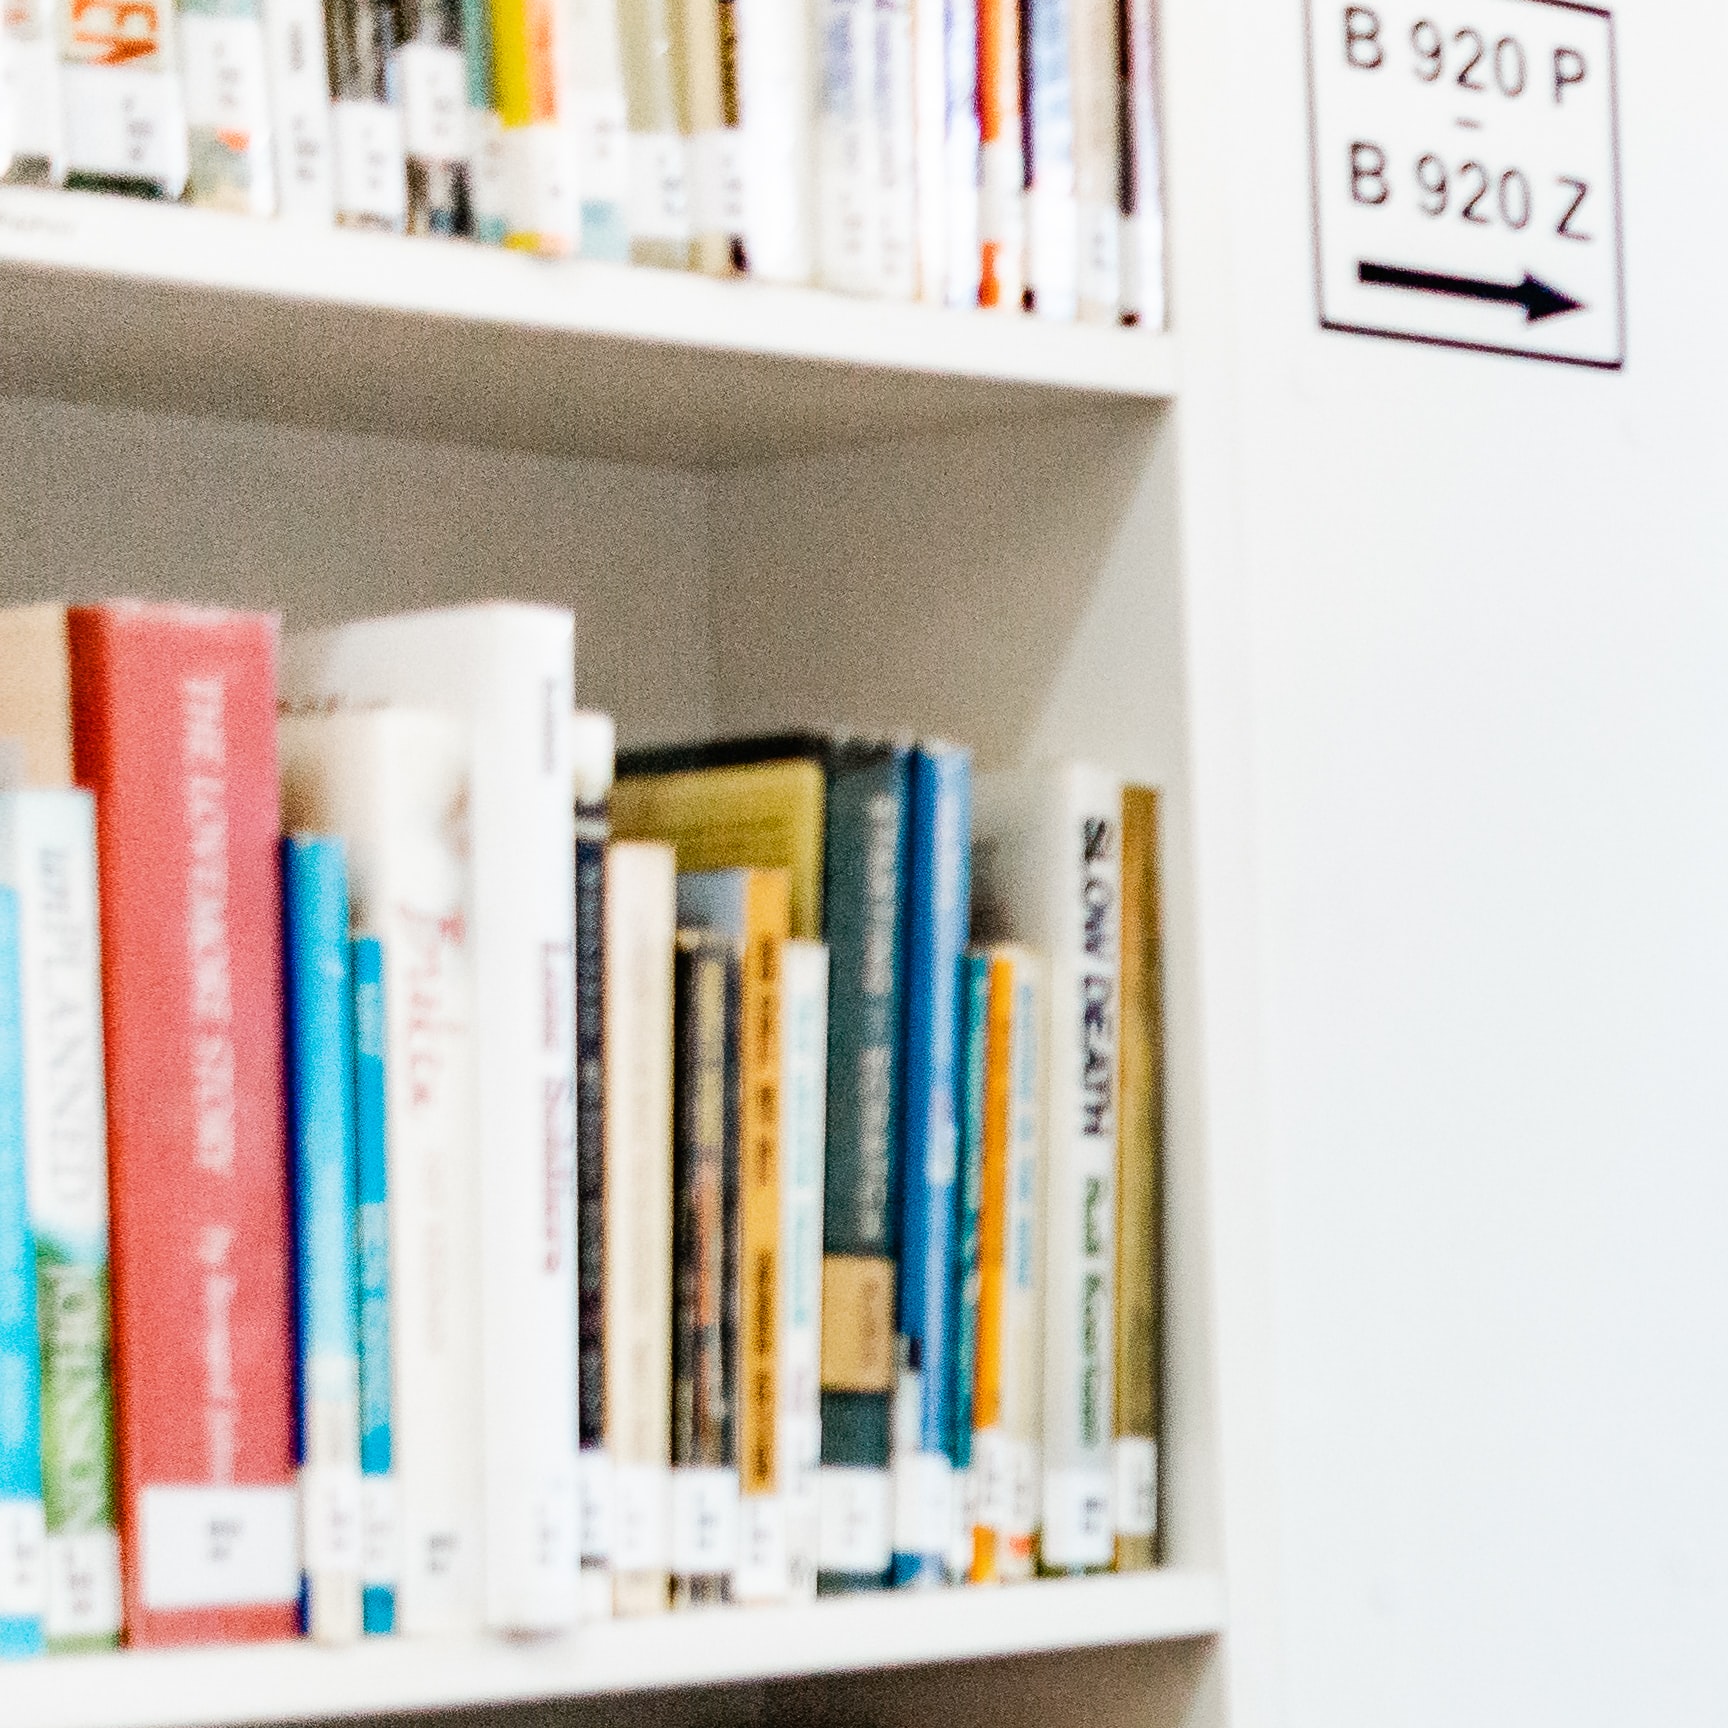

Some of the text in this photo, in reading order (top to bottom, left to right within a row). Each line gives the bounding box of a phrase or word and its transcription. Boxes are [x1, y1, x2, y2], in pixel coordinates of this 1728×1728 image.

[1345, 5, 1588, 103] B 920 P
[1350, 140, 1593, 243] B 920 Z
[1081, 817, 1112, 1136] SLOW DEATH
